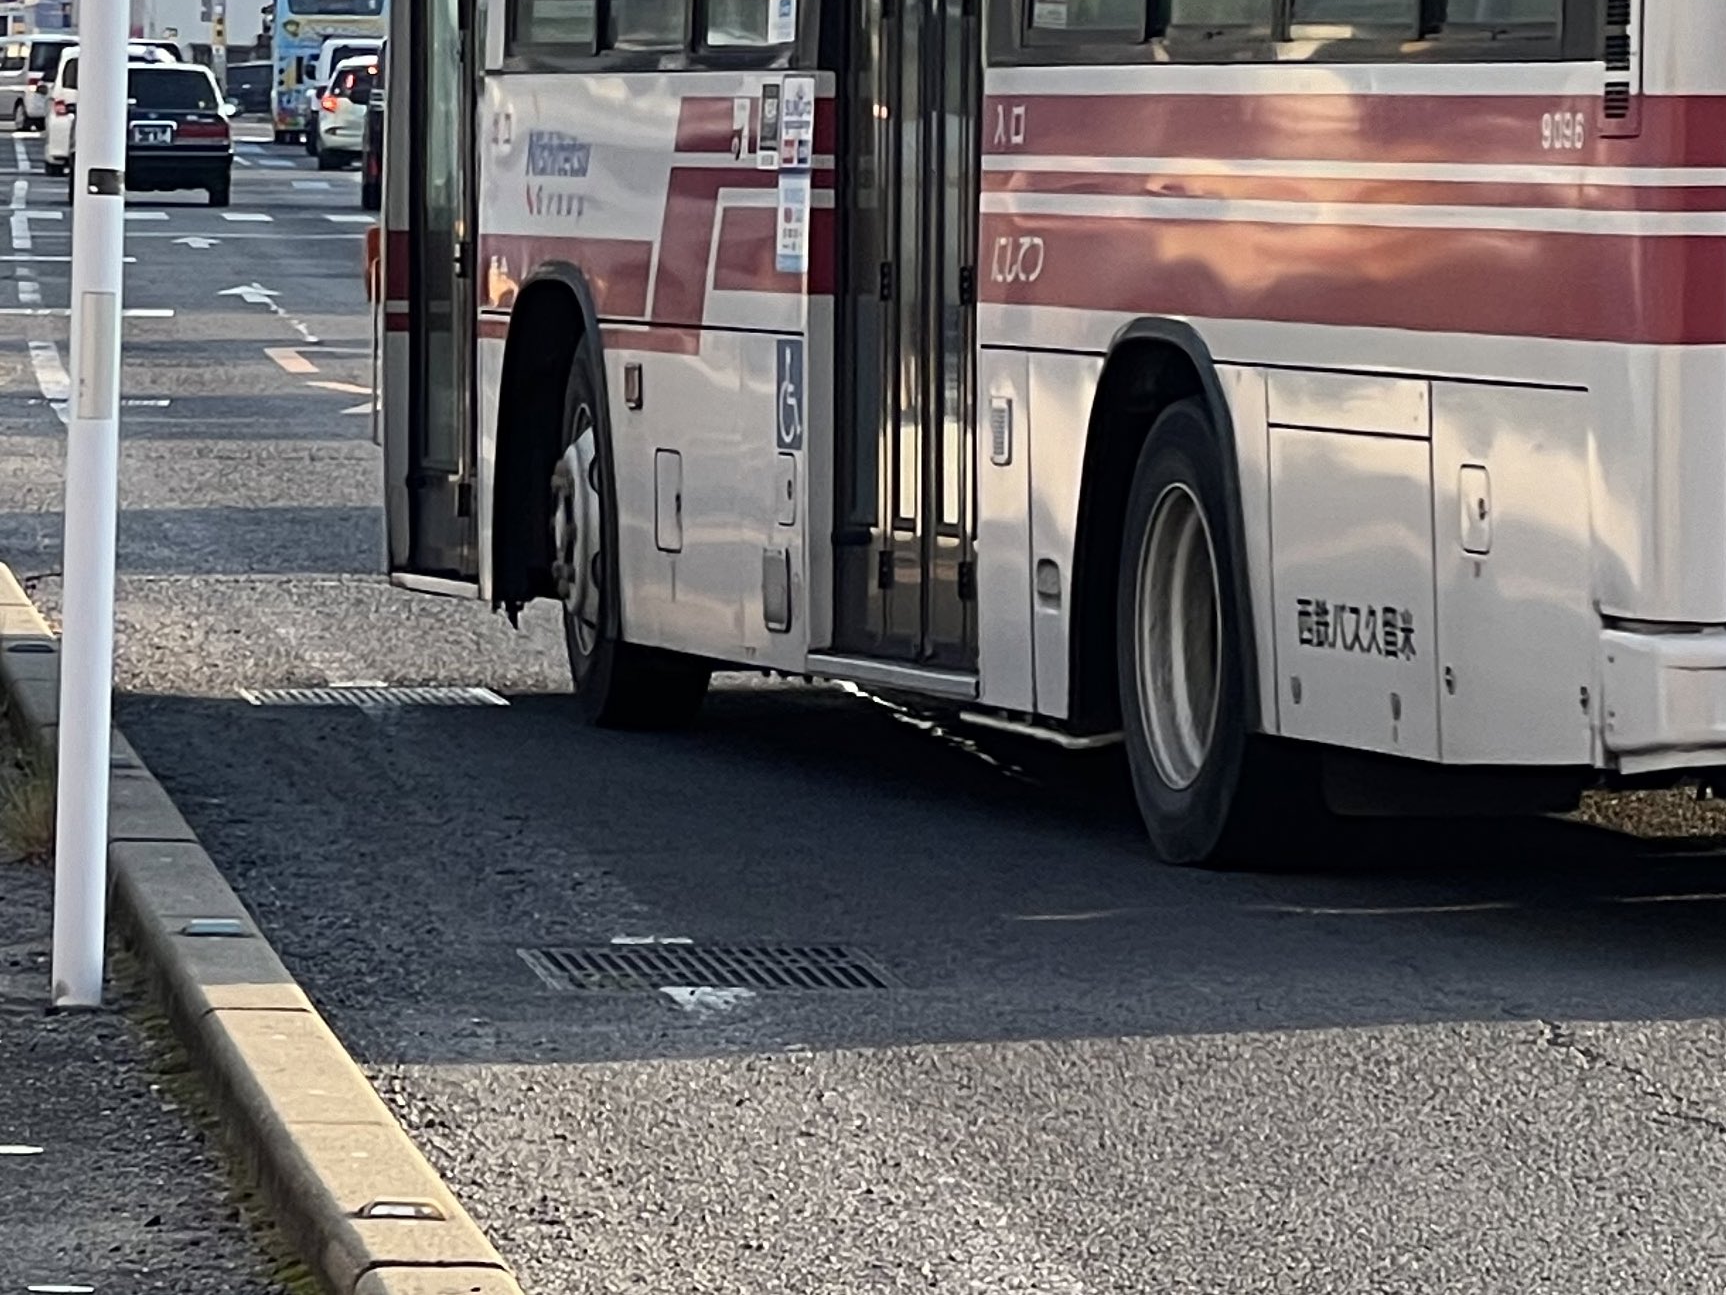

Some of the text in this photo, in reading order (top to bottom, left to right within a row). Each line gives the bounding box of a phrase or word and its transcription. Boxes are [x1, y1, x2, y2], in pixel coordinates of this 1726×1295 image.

[1541, 112, 1585, 150] 9096
[1297, 597, 1417, 662] 西鉄バス久留米
